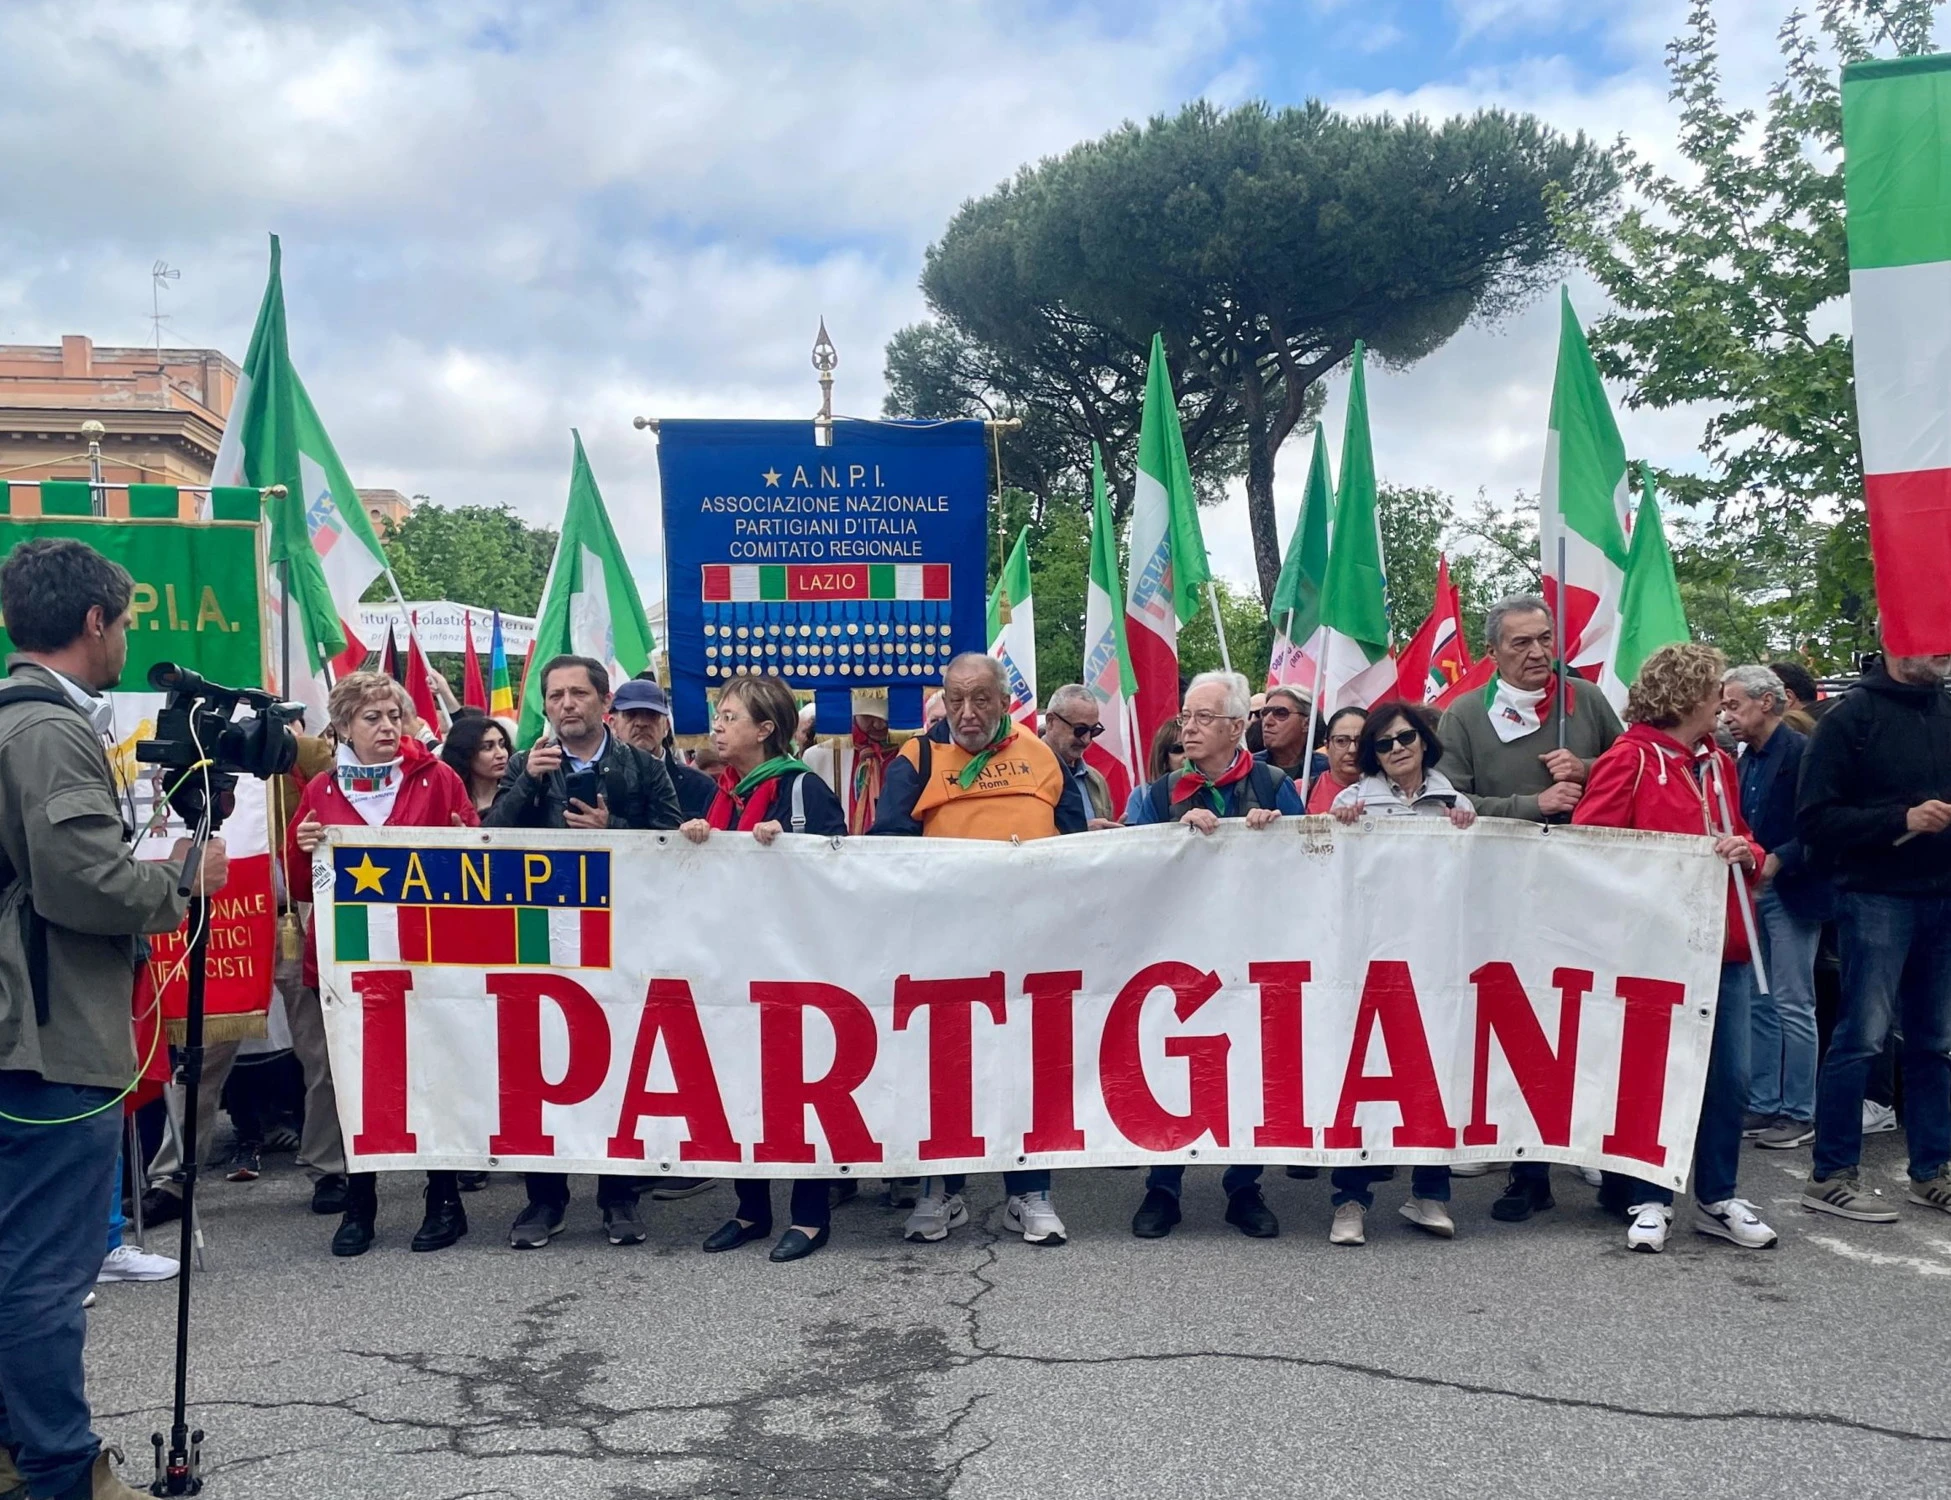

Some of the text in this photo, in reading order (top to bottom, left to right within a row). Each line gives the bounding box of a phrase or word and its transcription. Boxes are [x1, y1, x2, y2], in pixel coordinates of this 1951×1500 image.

[701, 495, 949, 513] ASSOCIAZIONE NAZIONALE
[735, 518, 917, 535] PARTIGIANI D'ITALIA
[730, 540, 923, 558] COMITATO REGIONALE
[799, 574, 856, 591] LAZIO
[978, 779, 1009, 790] Roma
[401, 851, 606, 904] A.N.P.I.
[351, 960, 1686, 1168] I PARTIGIANI
